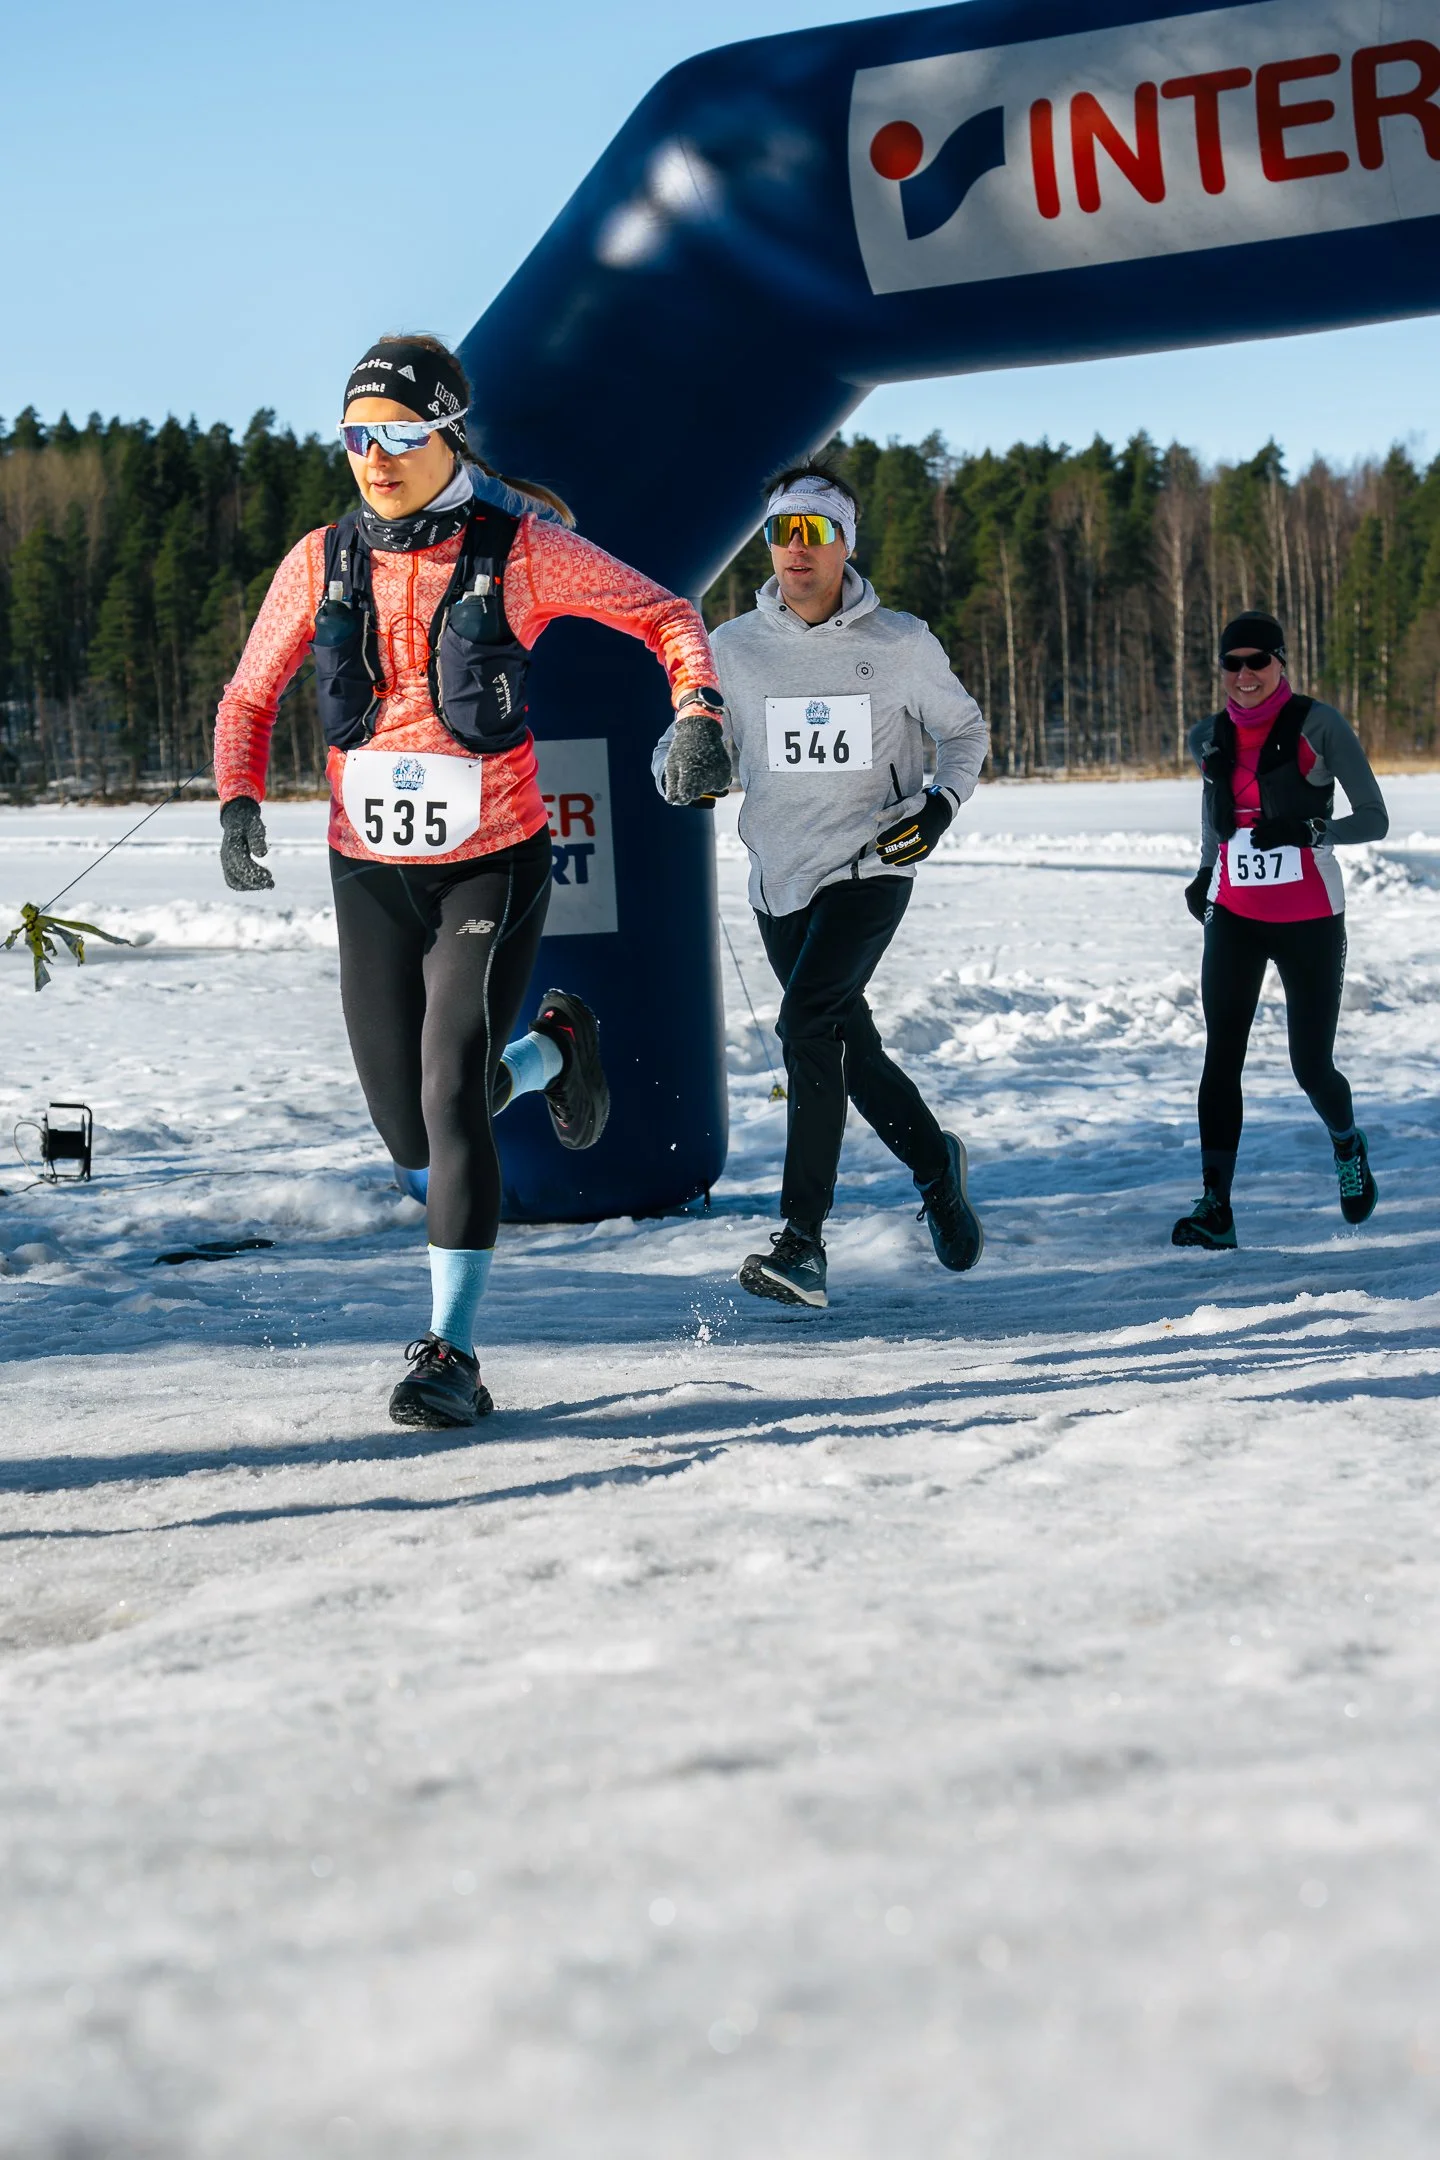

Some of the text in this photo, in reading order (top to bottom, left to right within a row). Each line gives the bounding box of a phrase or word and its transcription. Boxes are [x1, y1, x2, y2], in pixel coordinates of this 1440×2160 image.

[1029, 39, 1440, 219] INTER
[784, 729, 850, 765] 546
[392, 773, 425, 784] SAIMAA
[365, 798, 447, 847] 535
[1237, 852, 1283, 881] 537
